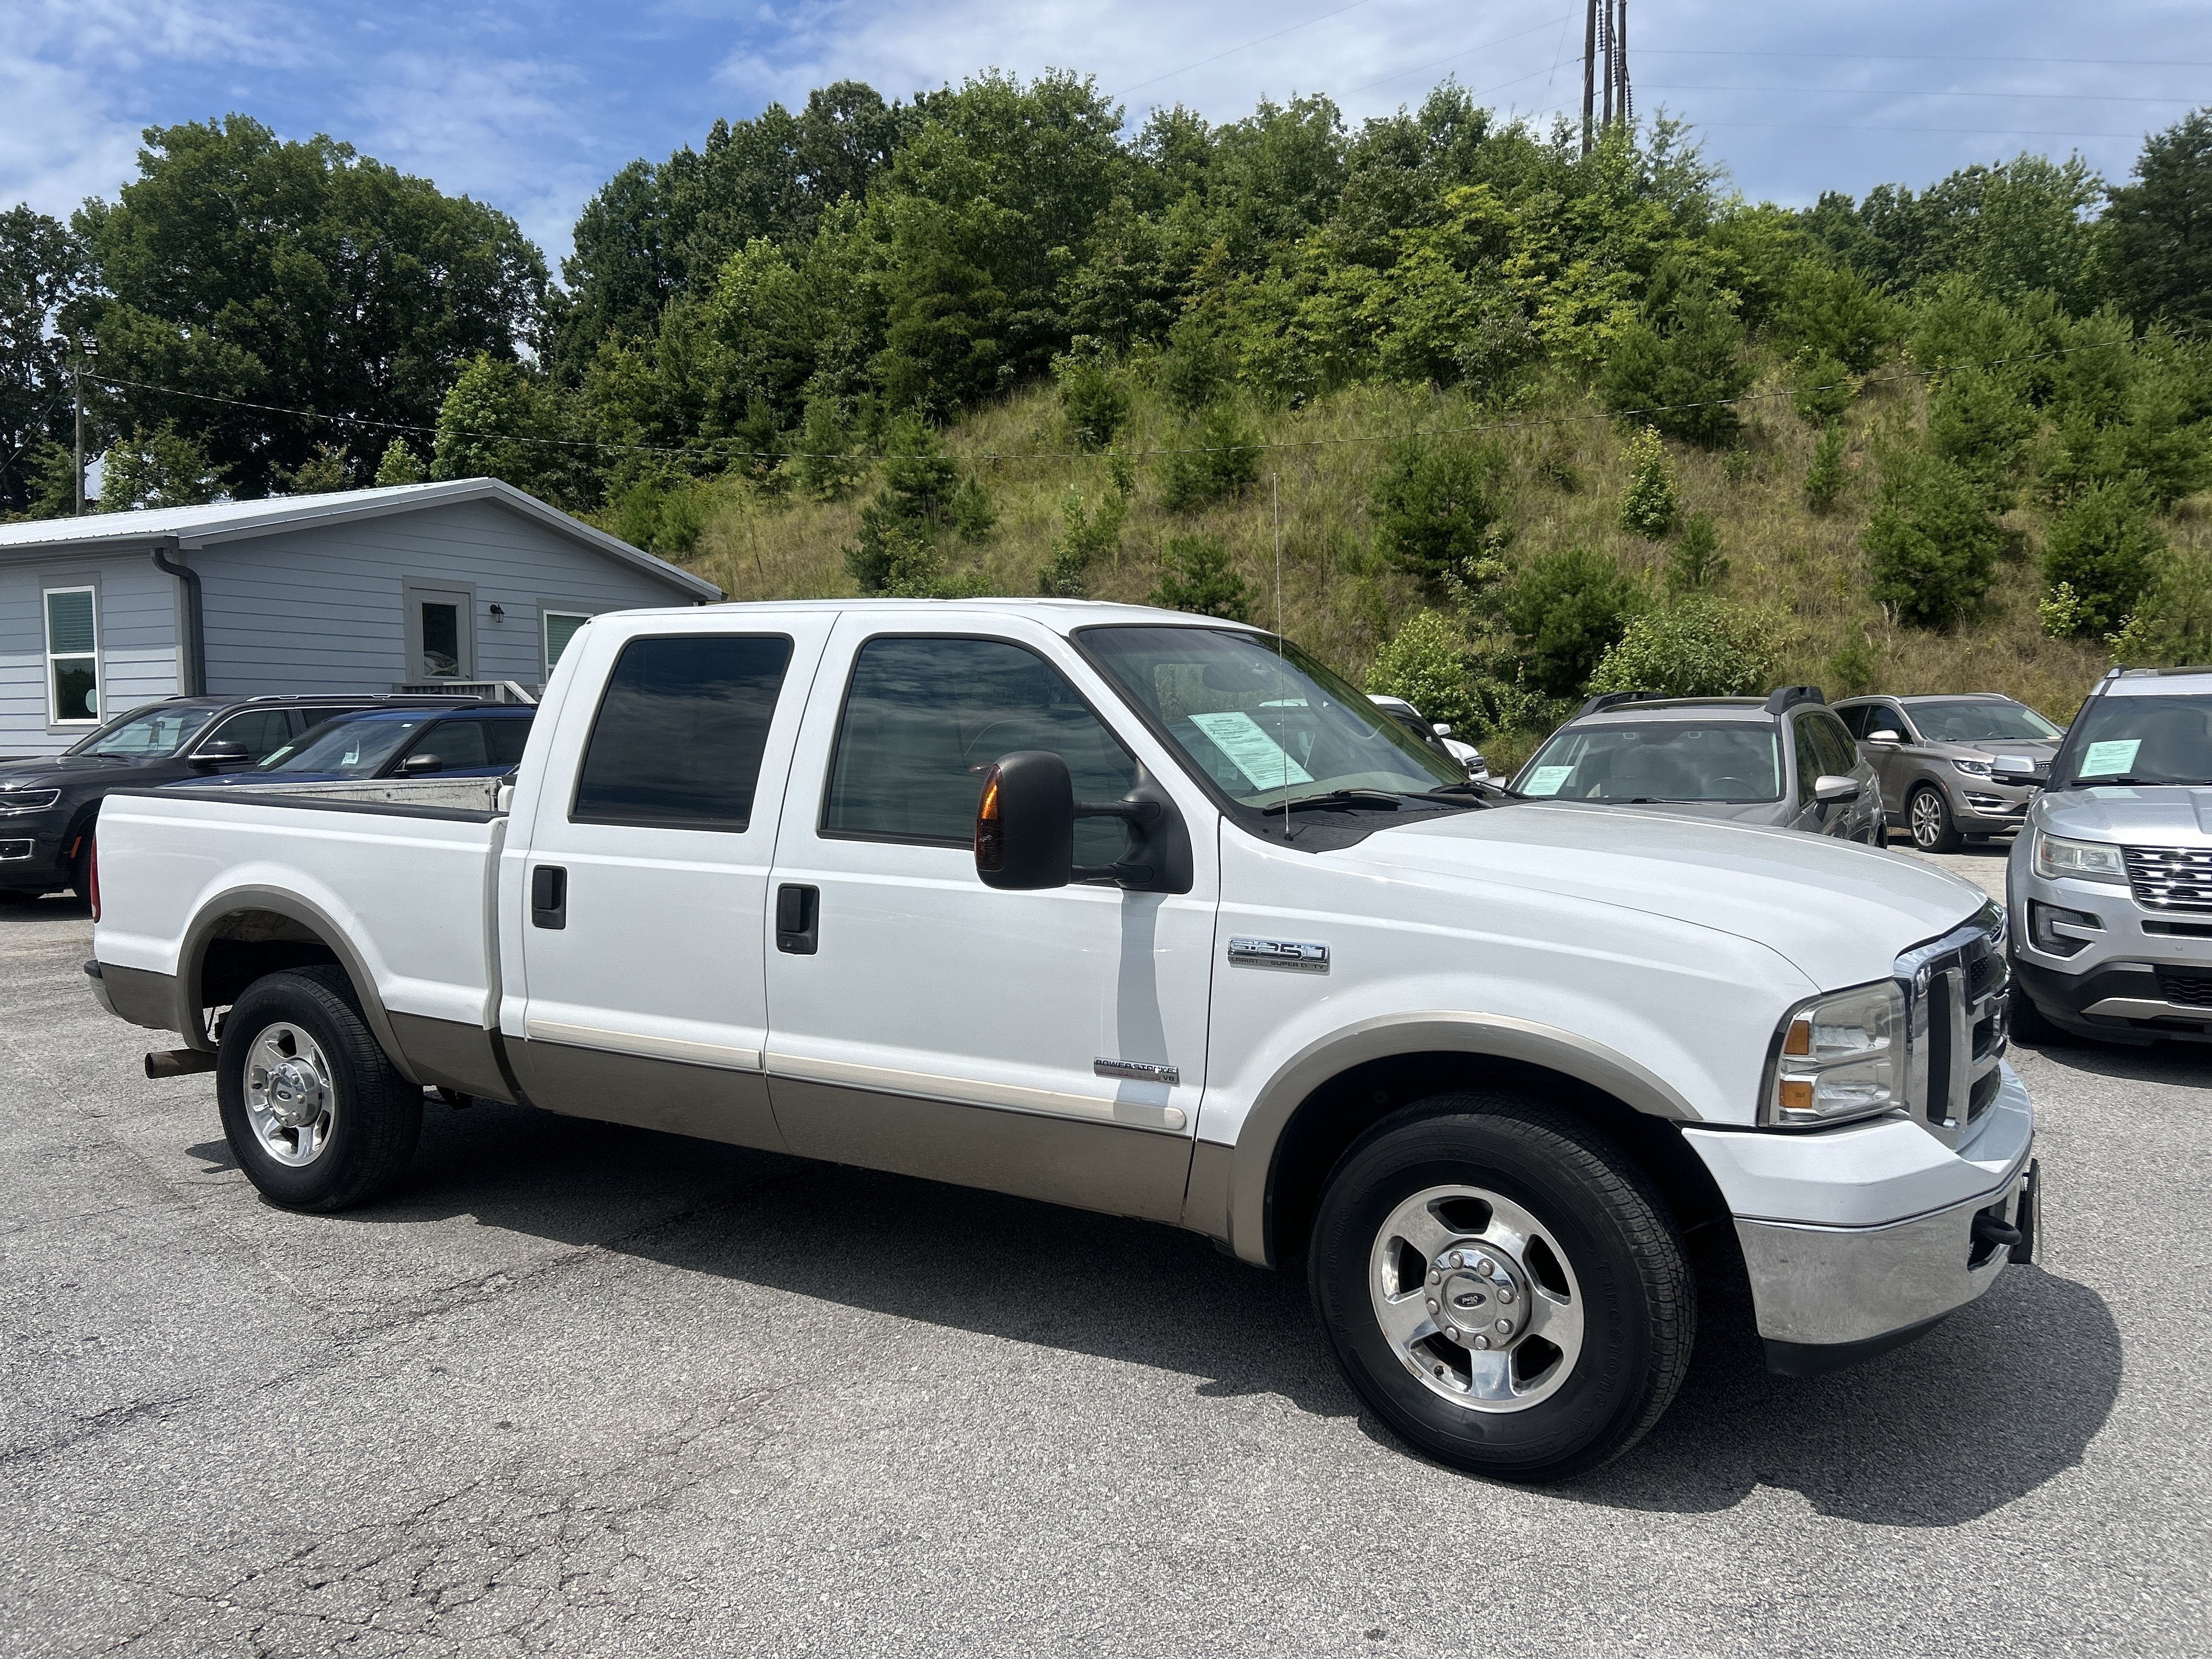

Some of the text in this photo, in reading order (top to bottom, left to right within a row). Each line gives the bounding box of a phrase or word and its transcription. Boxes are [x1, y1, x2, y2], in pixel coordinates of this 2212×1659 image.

[1229, 939, 1326, 961] F-250
[1325, 1206, 1352, 1340] Firestone
[1593, 1260, 1625, 1408] Firestone
